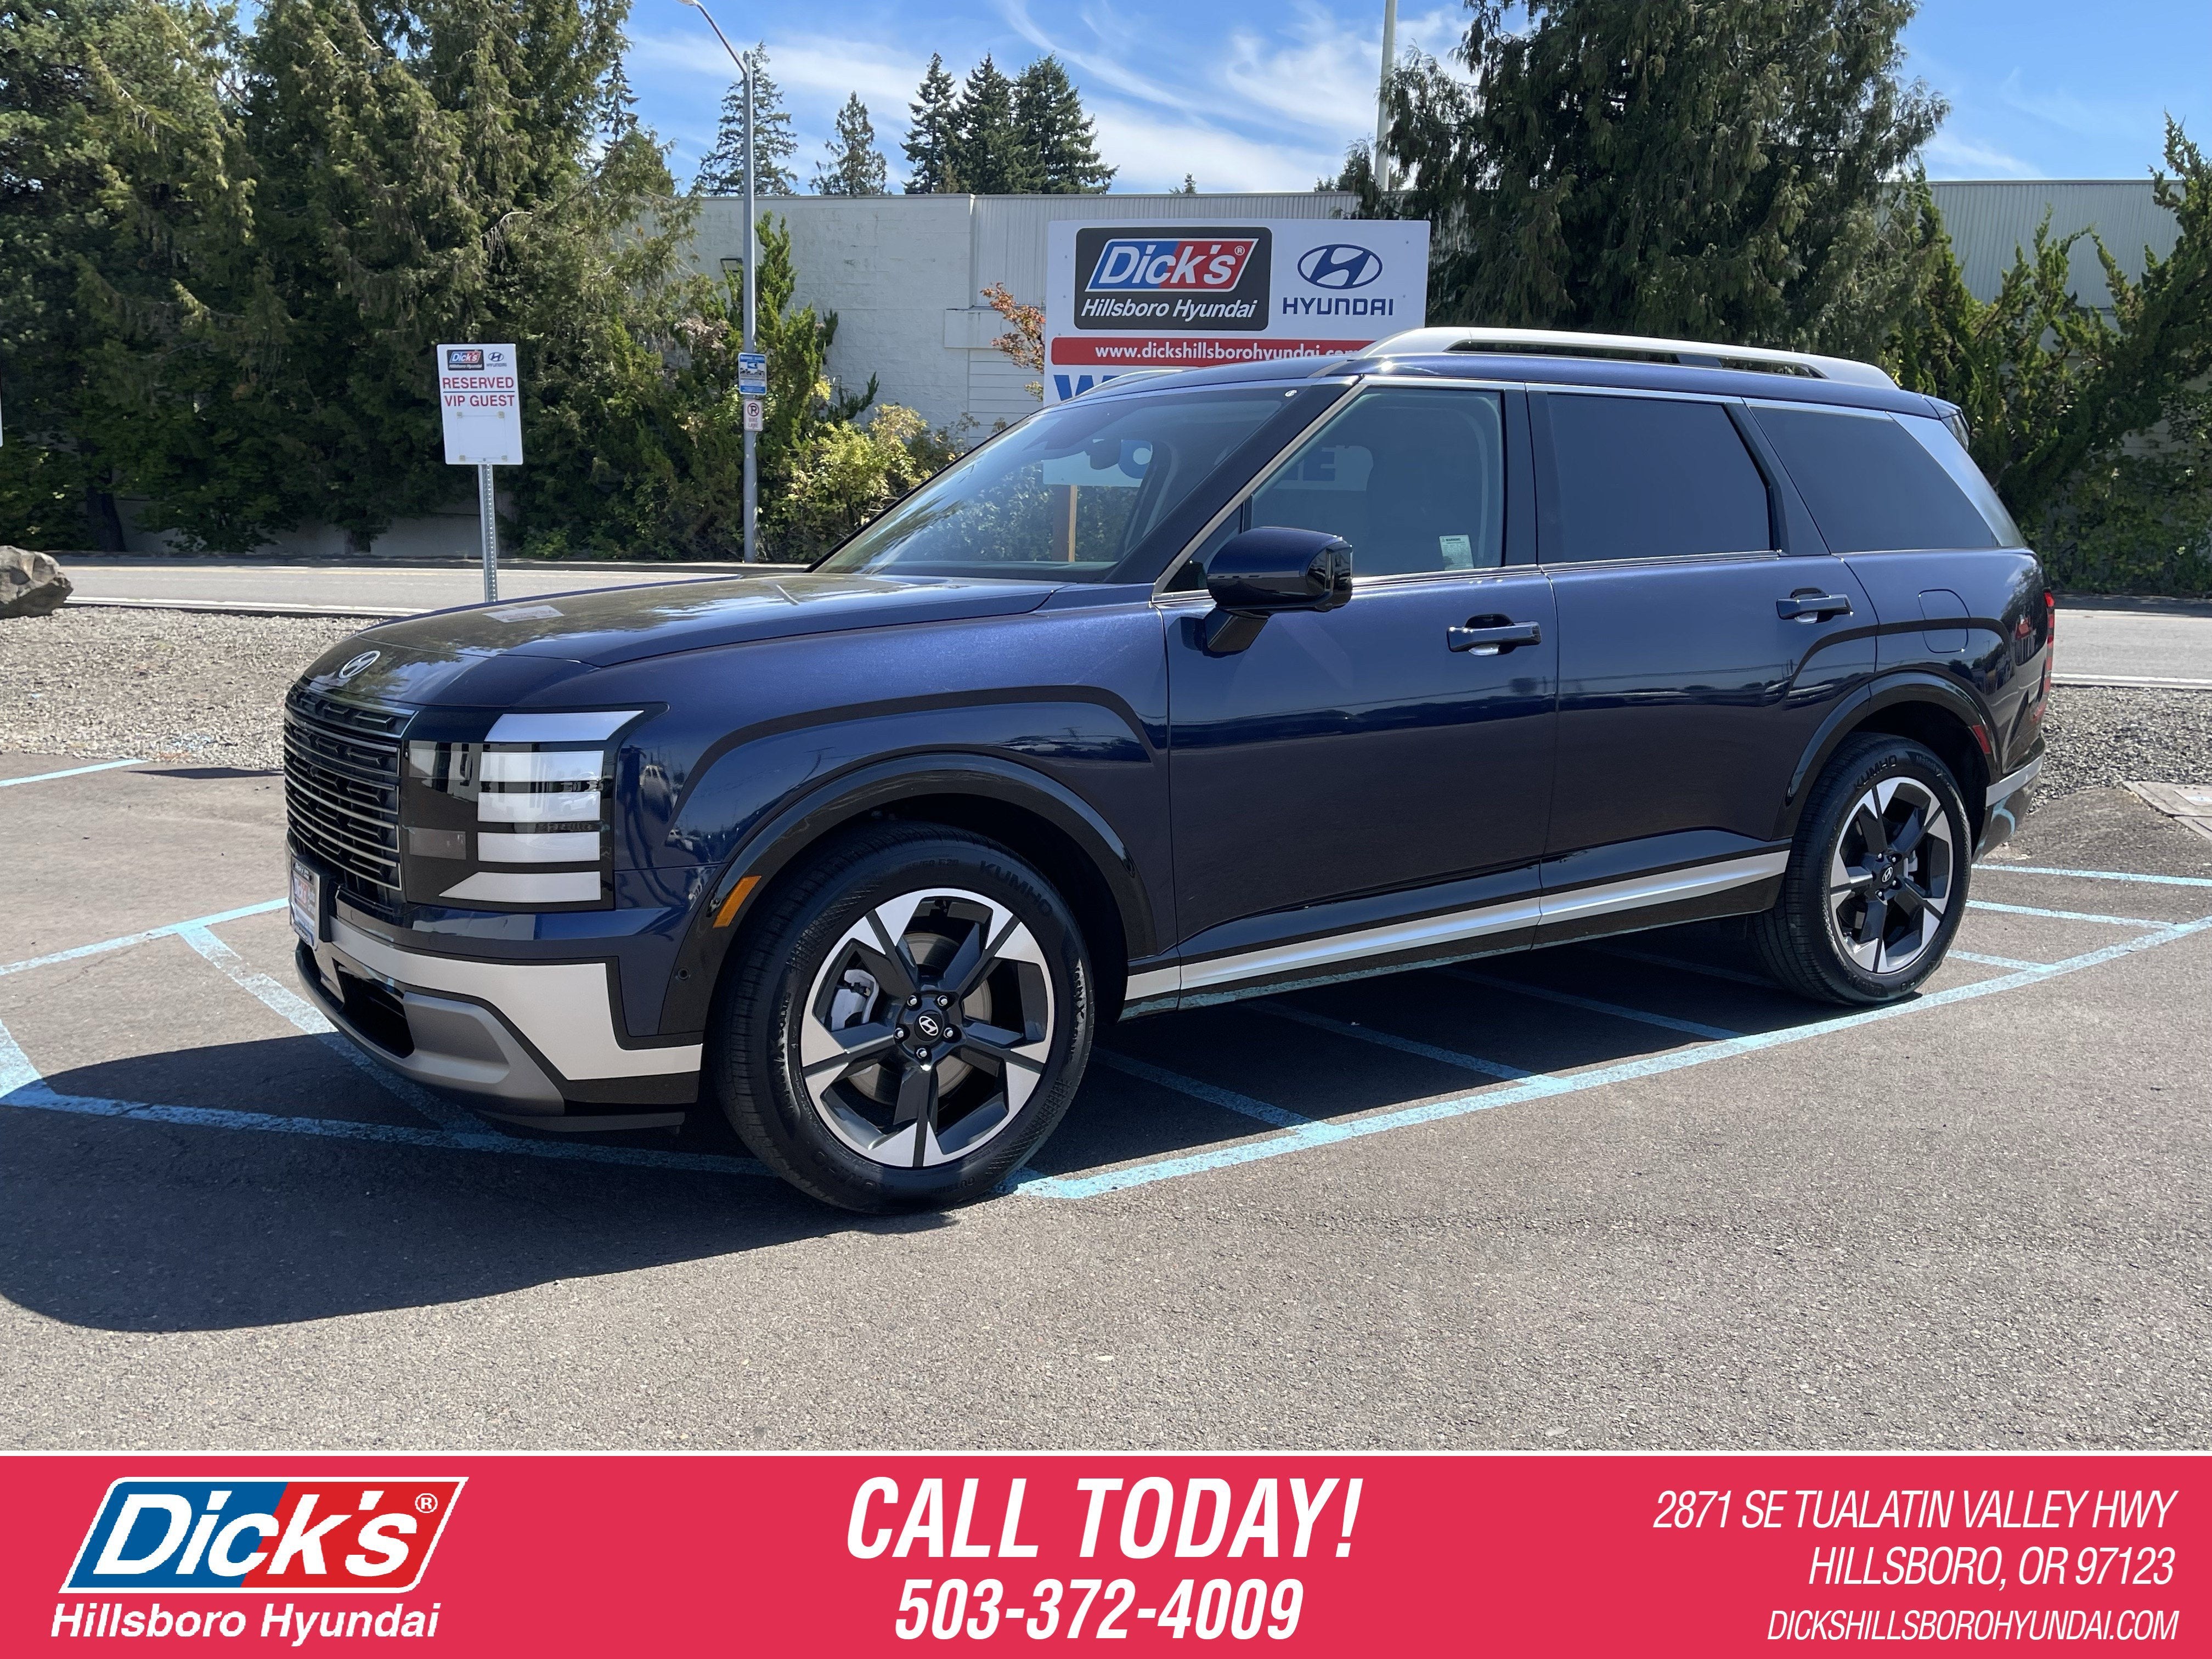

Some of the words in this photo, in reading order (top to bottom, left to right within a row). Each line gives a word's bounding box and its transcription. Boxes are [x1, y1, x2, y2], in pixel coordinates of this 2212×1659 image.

[1081, 298, 1169, 317] Hillsboro
[1172, 299, 1258, 321] Hyundai
[1283, 297, 1394, 316] HYUNDAI
[442, 376, 514, 389] RESERVED
[444, 395, 465, 407] VIP
[470, 394, 515, 407] GUEST
[979, 860, 1054, 913] KUMHO
